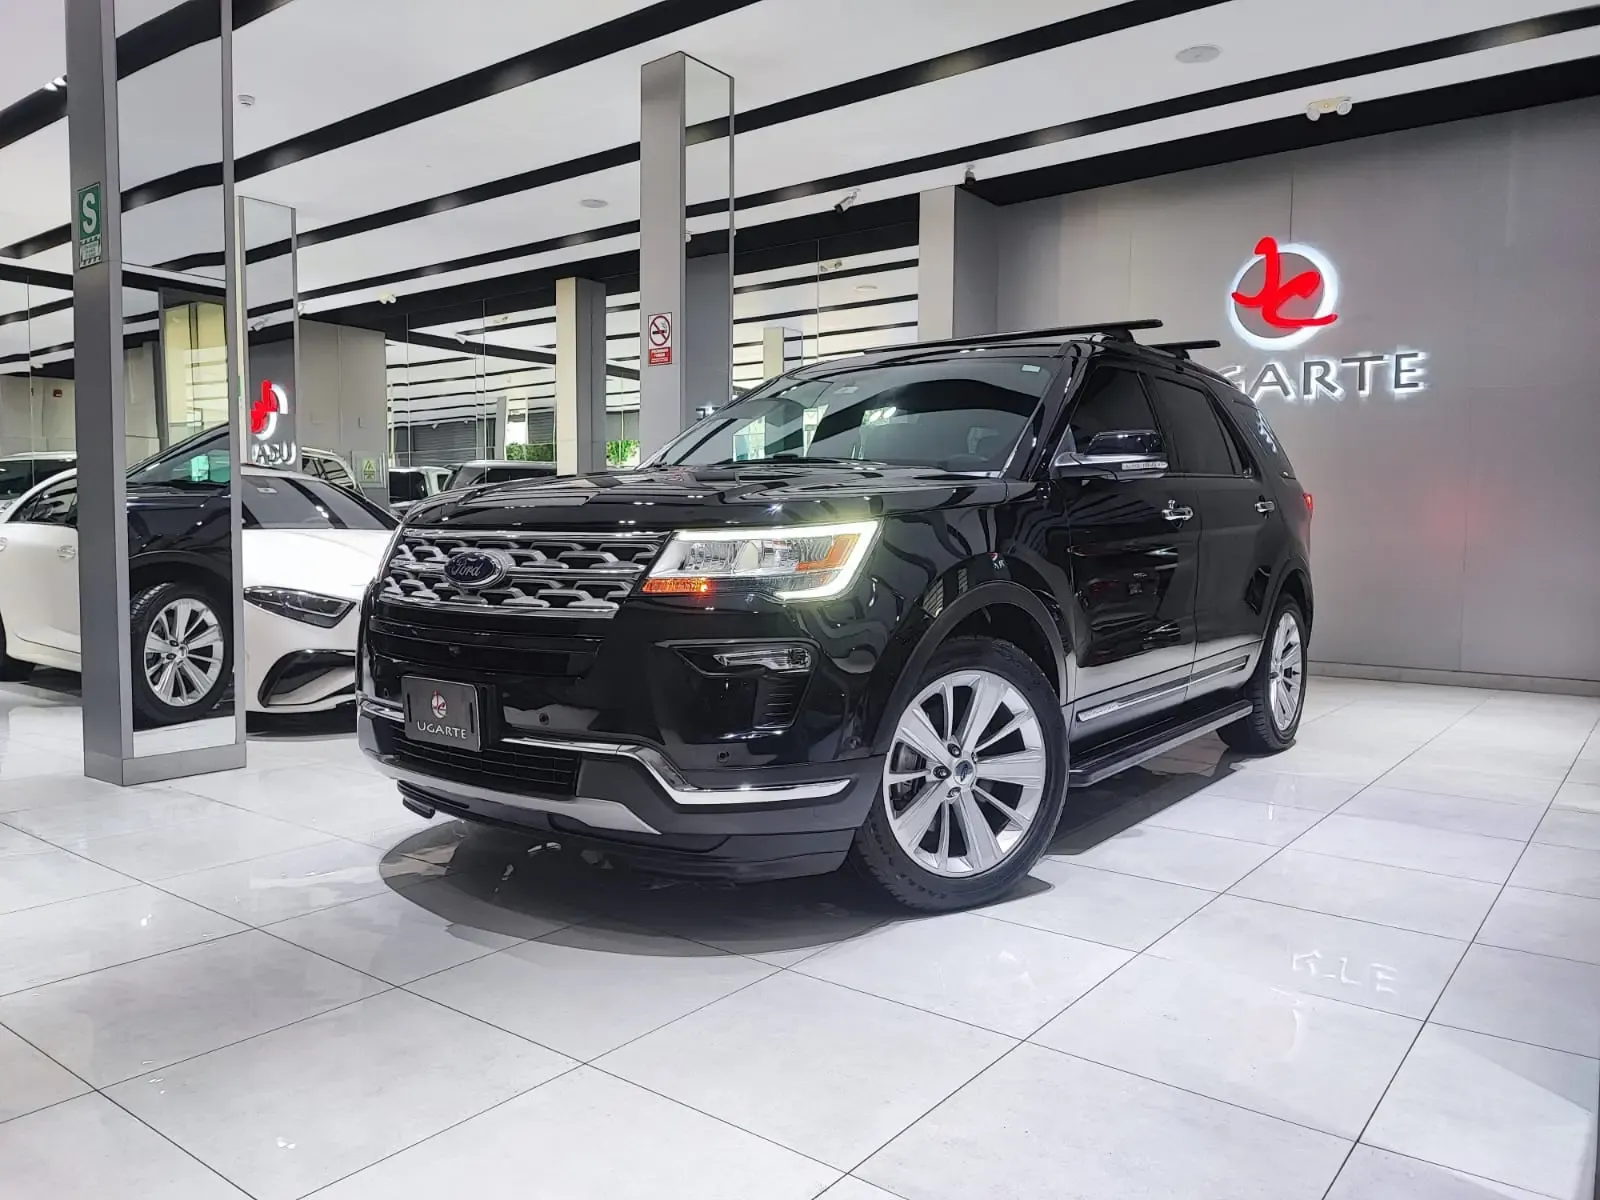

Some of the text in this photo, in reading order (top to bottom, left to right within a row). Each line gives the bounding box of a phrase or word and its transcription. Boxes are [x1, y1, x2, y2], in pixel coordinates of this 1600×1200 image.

[82, 192, 97, 234] S
[449, 556, 484, 577] Ford
[417, 721, 468, 740] UGARTE
